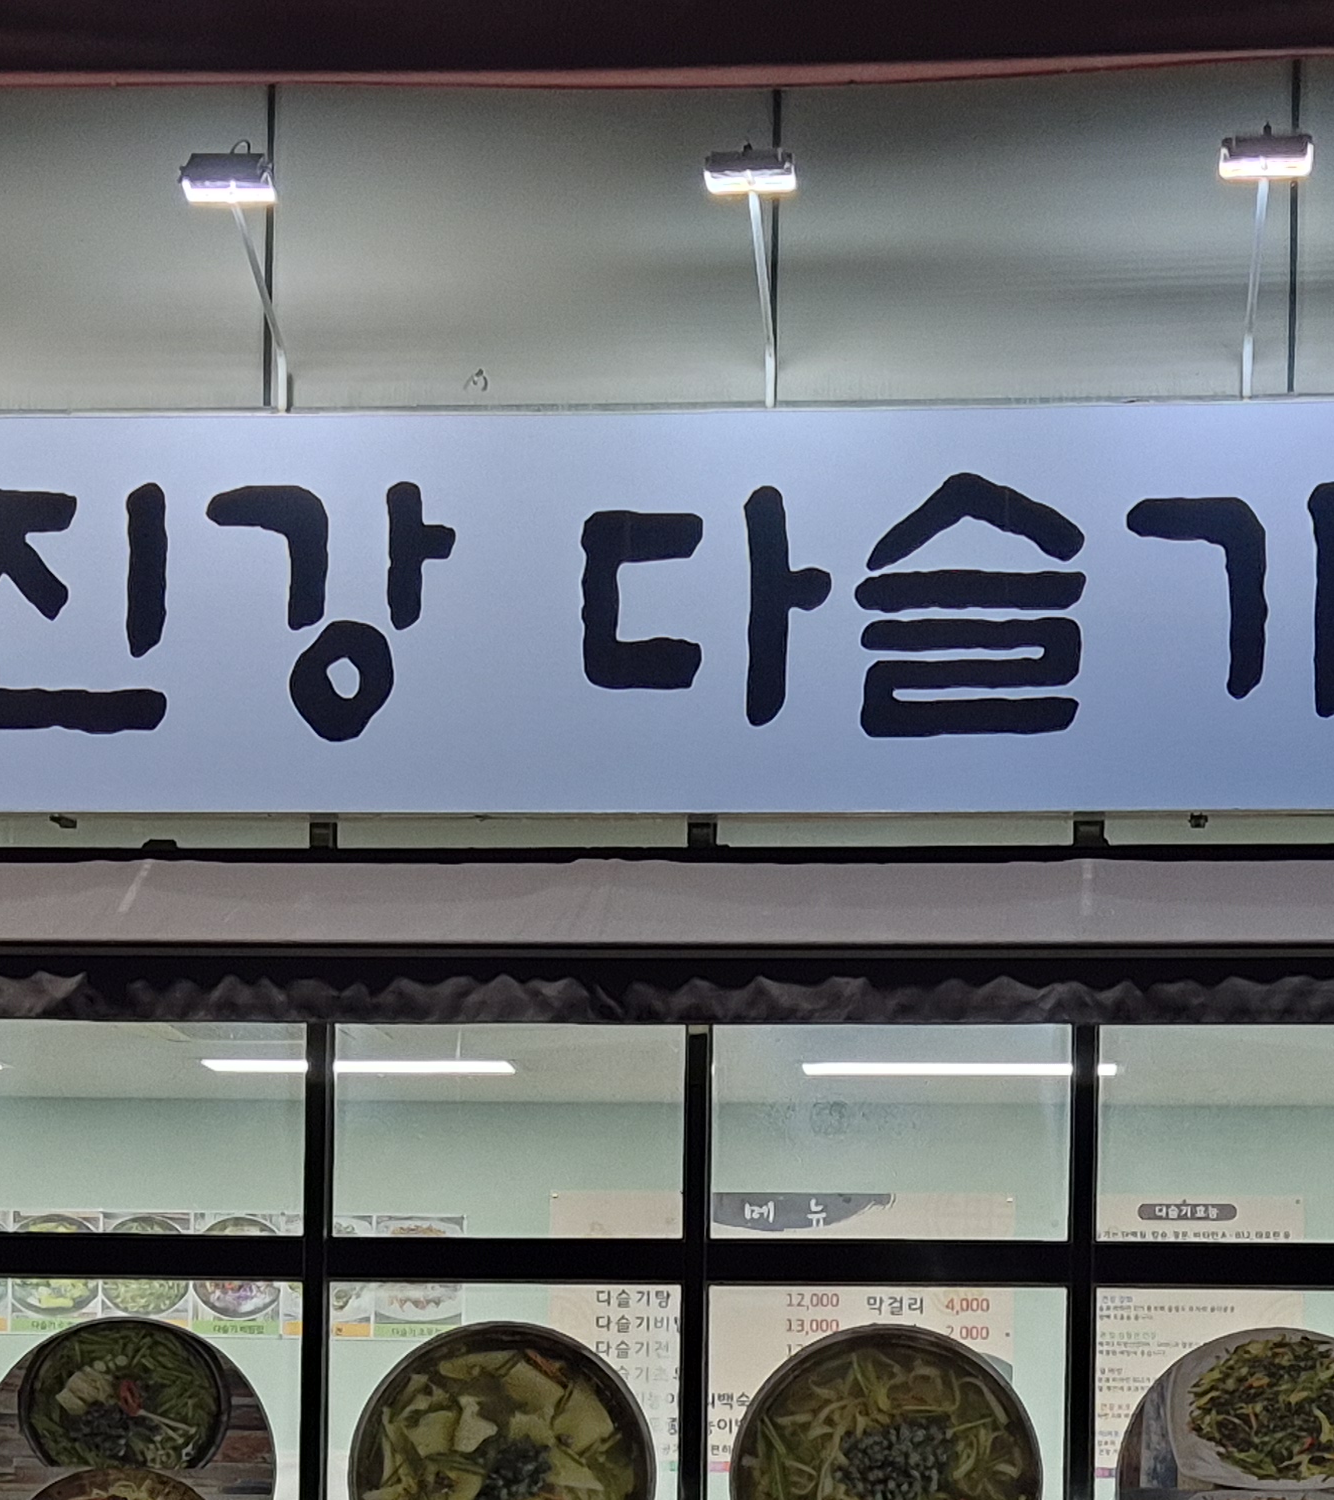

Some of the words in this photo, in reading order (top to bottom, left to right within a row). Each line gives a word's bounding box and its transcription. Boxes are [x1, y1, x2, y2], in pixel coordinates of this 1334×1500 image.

[1154, 1205, 1192, 1219] 다슬기
[595, 1289, 671, 1308] 다슬기탕
[786, 1293, 840, 1310] 12,000
[866, 1296, 925, 1315] 막걸리
[945, 1297, 990, 1315] 4,000
[786, 1318, 840, 1336] 13,000
